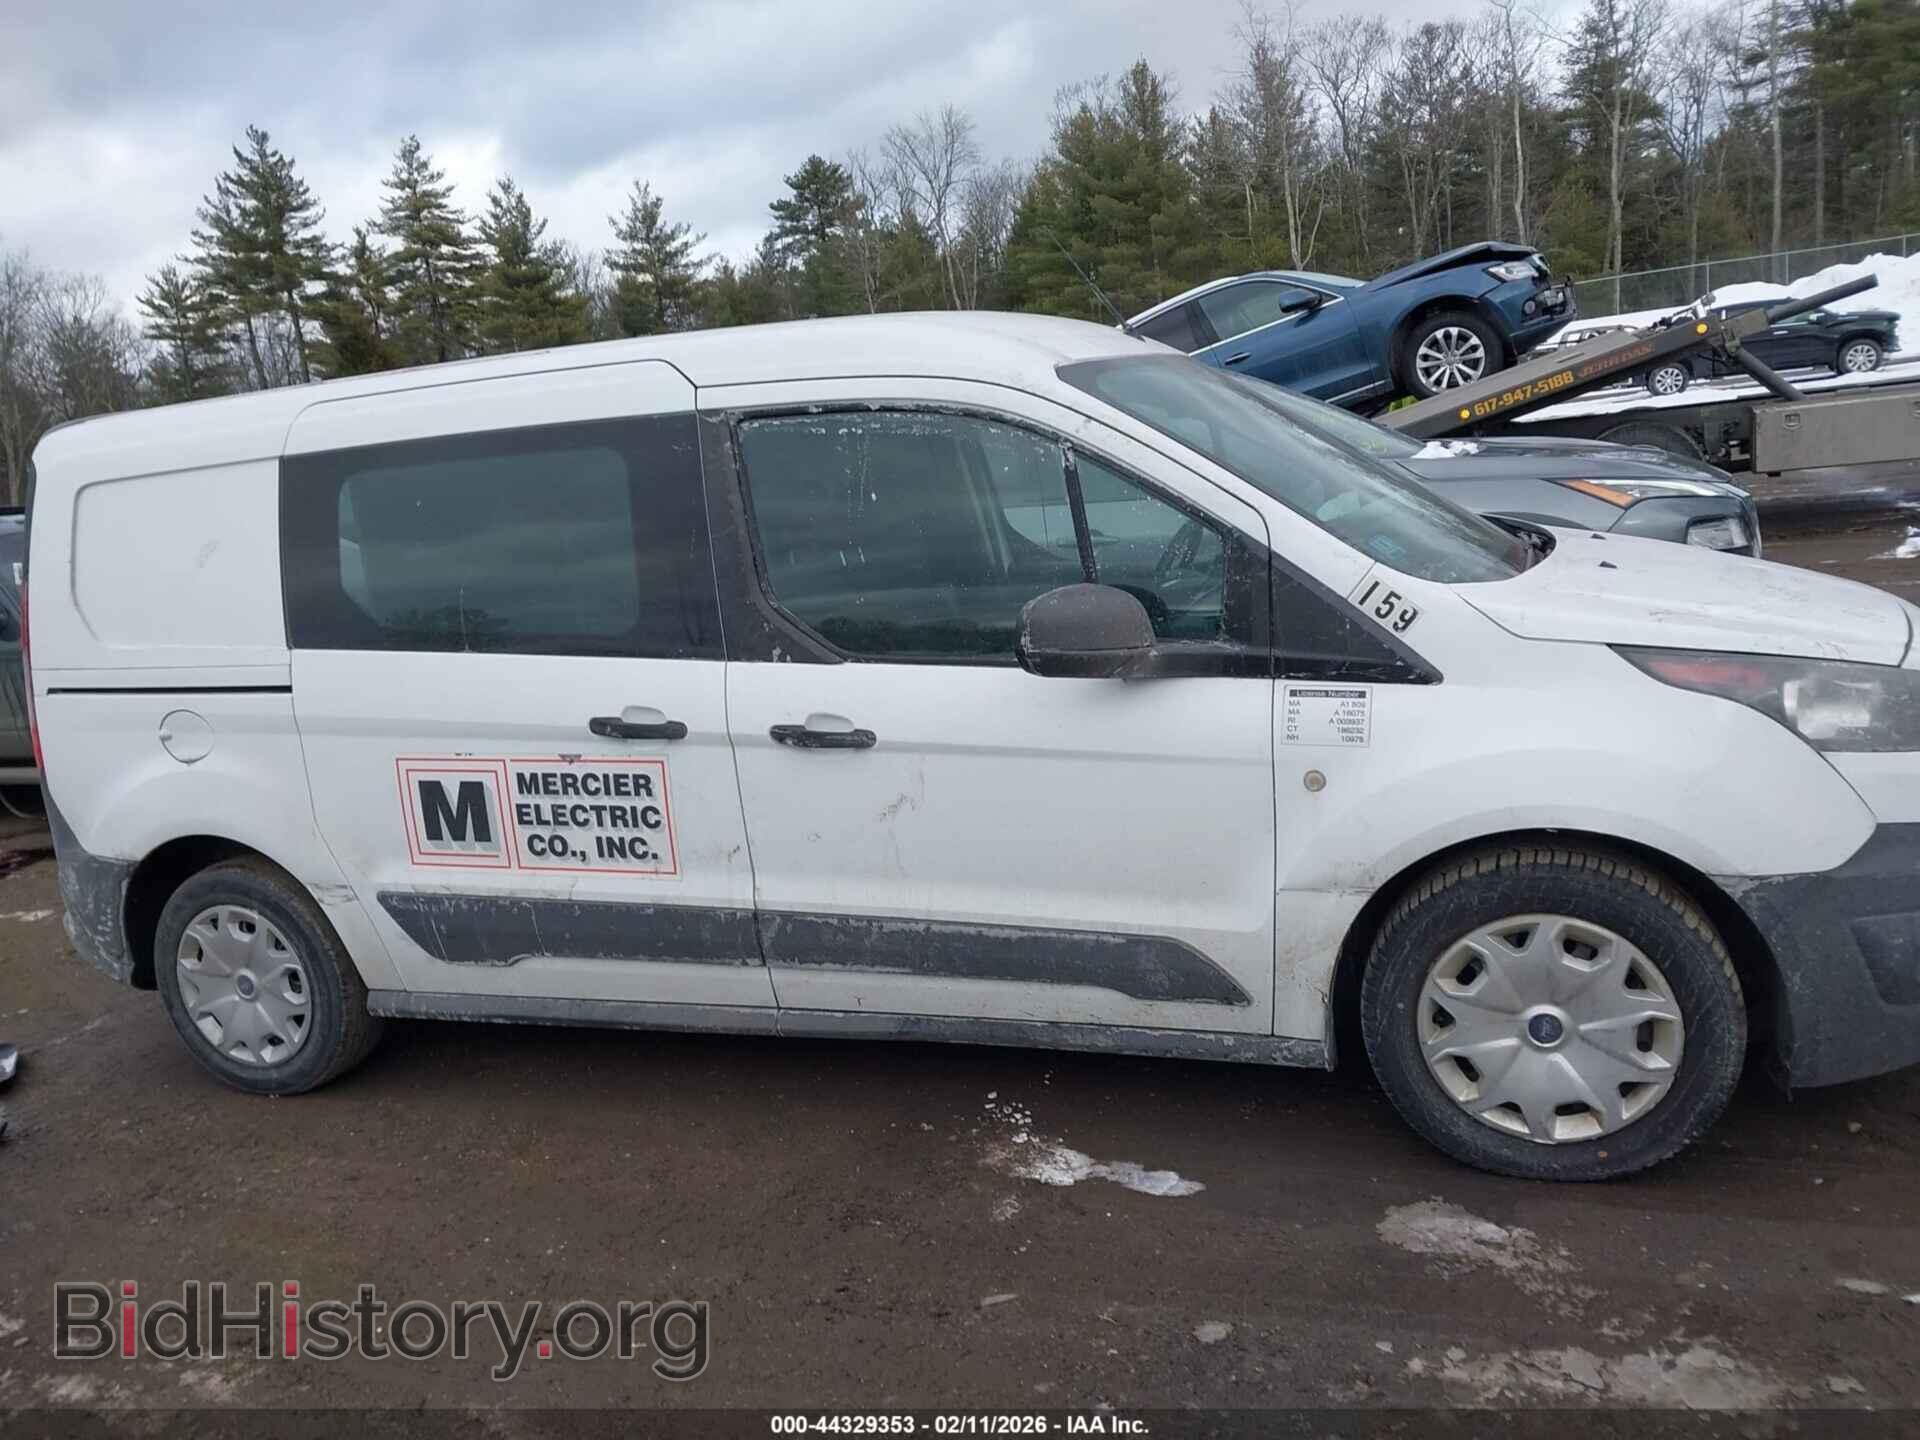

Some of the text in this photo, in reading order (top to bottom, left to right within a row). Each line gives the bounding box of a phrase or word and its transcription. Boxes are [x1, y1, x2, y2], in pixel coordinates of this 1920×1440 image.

[1474, 371, 1575, 416] 617-947-5188
[1358, 580, 1419, 632] 159
[1296, 690, 1360, 698] License Number
[515, 772, 653, 797] MERCIER
[418, 780, 492, 842] M
[515, 803, 662, 829] ELECTRIC
[527, 834, 659, 862] CO., INC.
